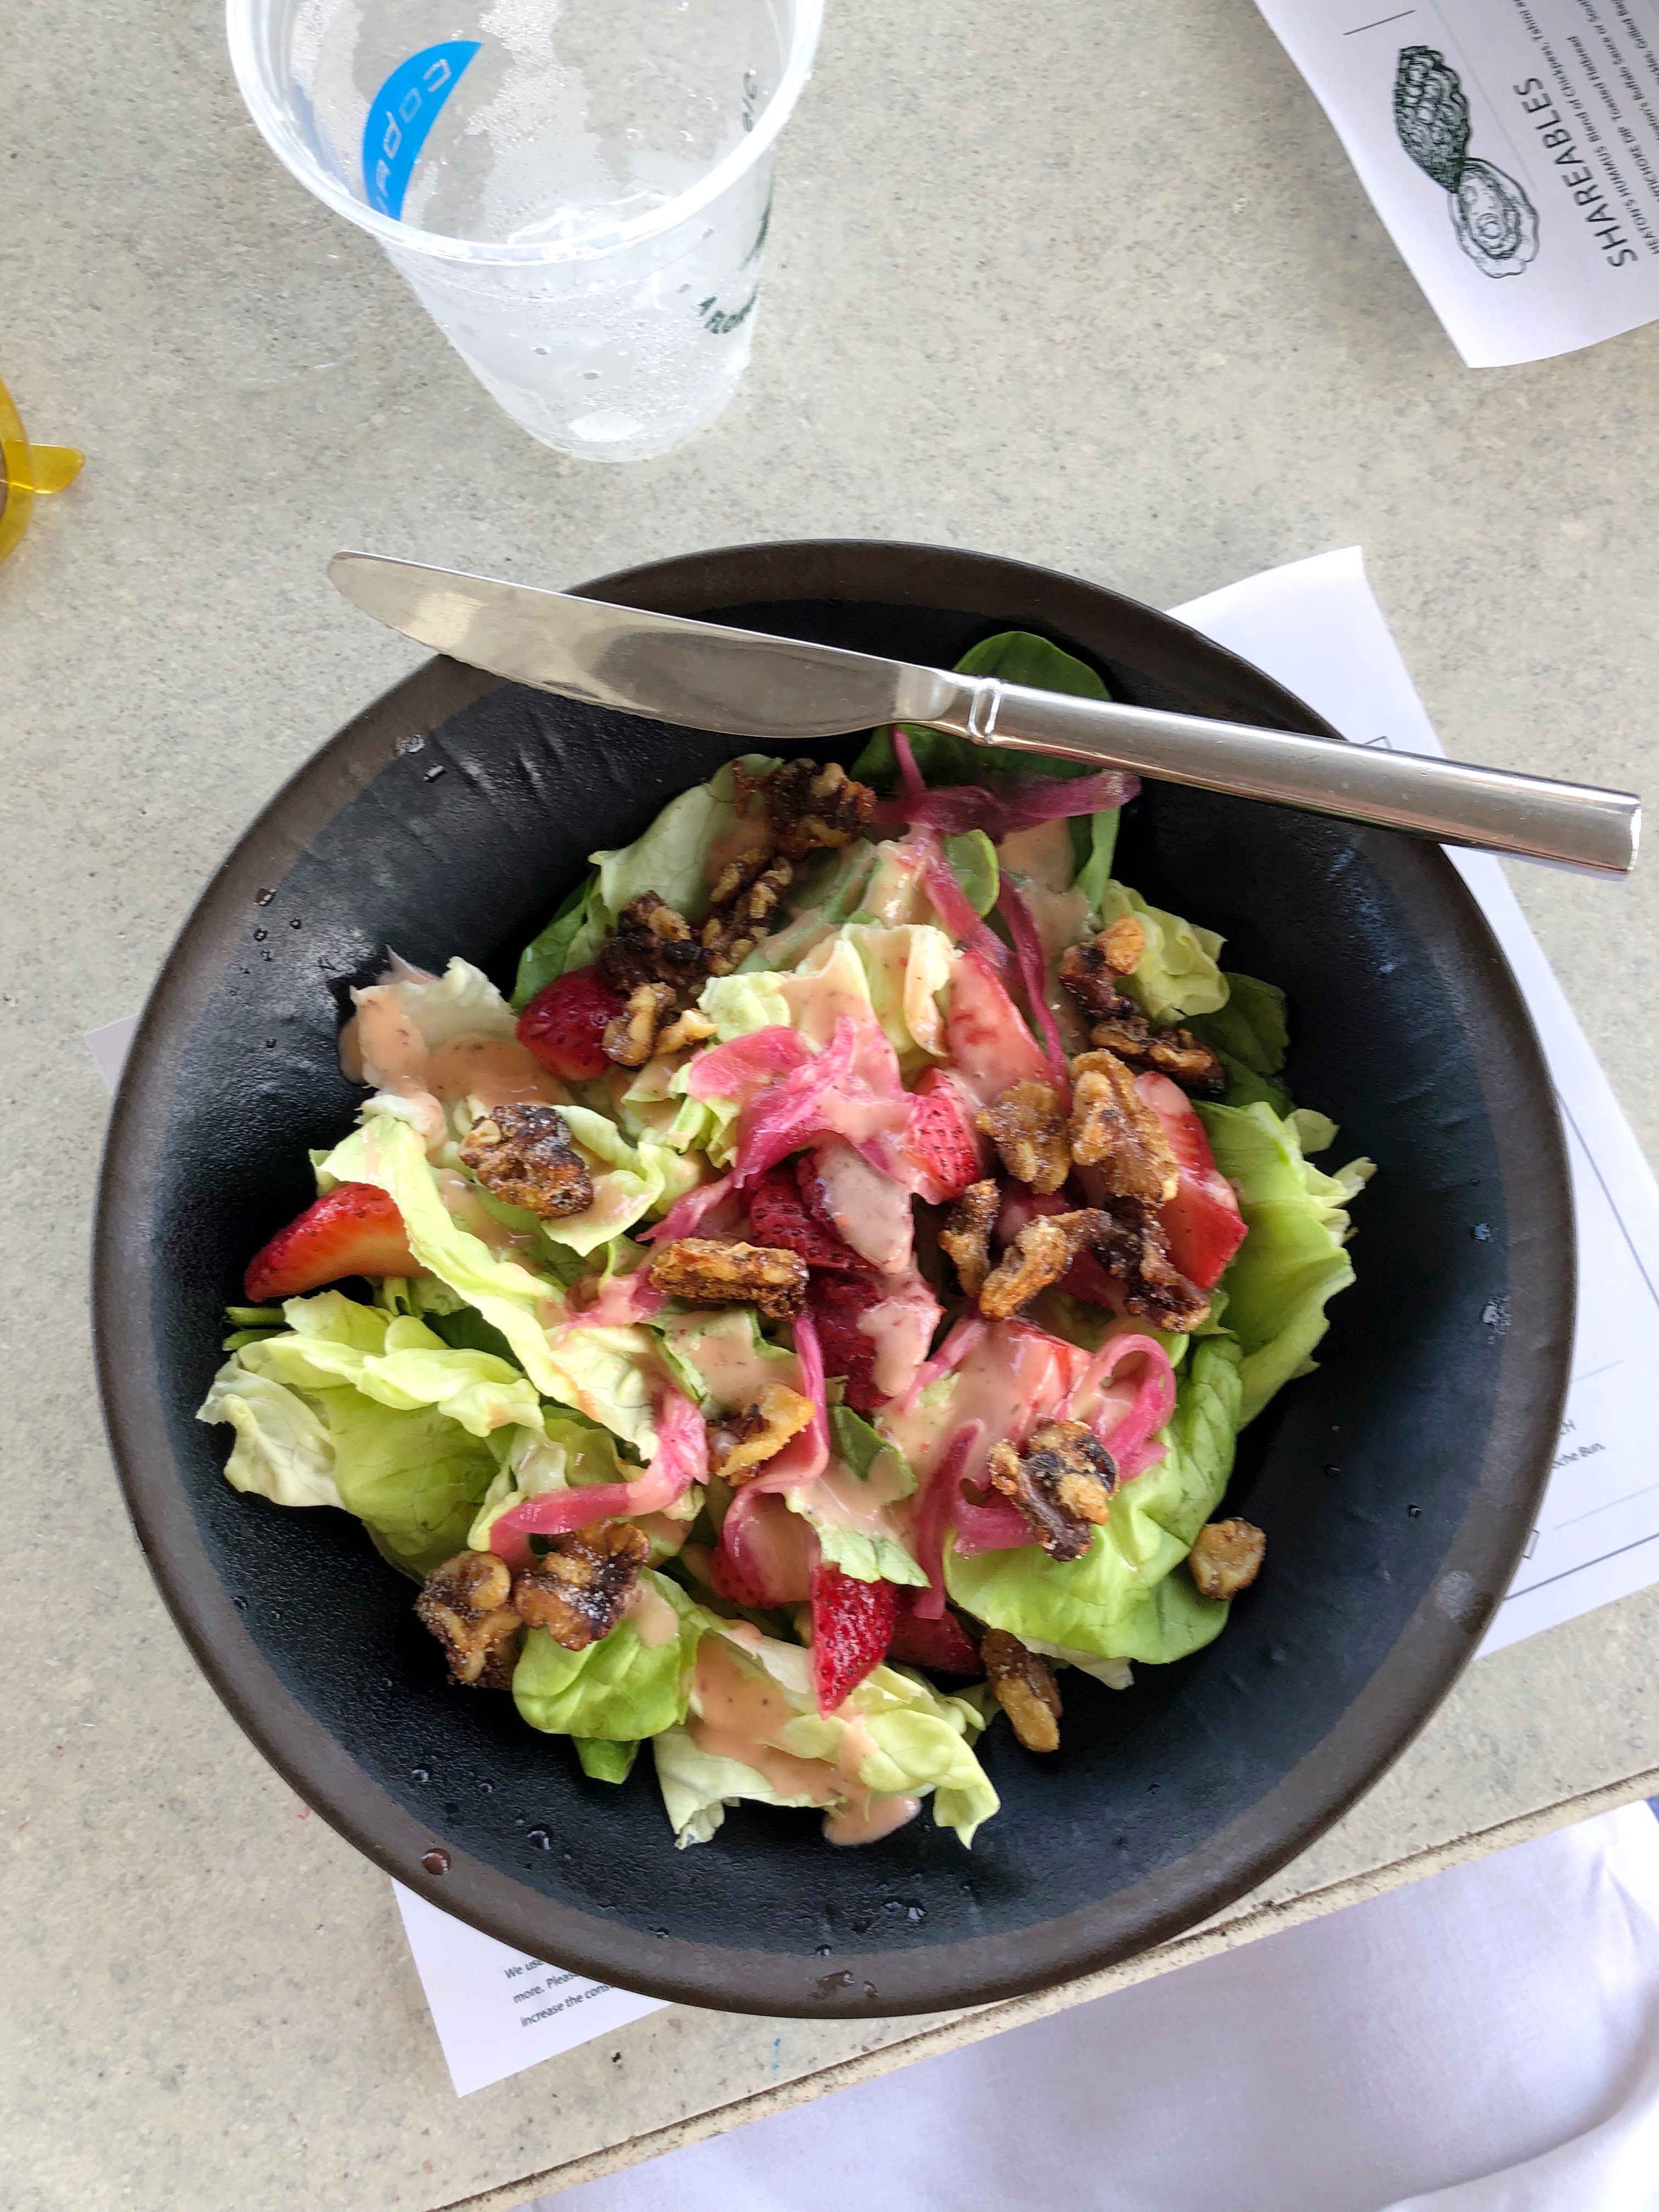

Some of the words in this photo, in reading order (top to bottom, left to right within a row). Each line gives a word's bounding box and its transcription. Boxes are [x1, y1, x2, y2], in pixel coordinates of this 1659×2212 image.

[1517, 10, 1544, 43] Tahini
[1593, 24, 1608, 35] or
[1620, 18, 1647, 49] Grilled
[1566, 35, 1602, 81] Flatbread
[1601, 36, 1626, 65] Sauce
[1540, 42, 1577, 97] Chickpeas,
[1618, 66, 1645, 101] Buffalo
[1565, 99, 1585, 110] of
[1591, 82, 1624, 123] Toasted
[1573, 111, 1602, 143] Blend
[1617, 126, 1637, 145] DIP
[1512, 77, 1639, 268] SHAREABLES
[1593, 145, 1633, 198] HUMMUS
[1626, 144, 1659, 203] RTICHOKE
[504, 1966, 523, 1979] We
[514, 1986, 545, 2003] more.
[546, 1973, 580, 1989] Pleas
[565, 1994, 584, 2007] the
[584, 1984, 615, 1999] cons
